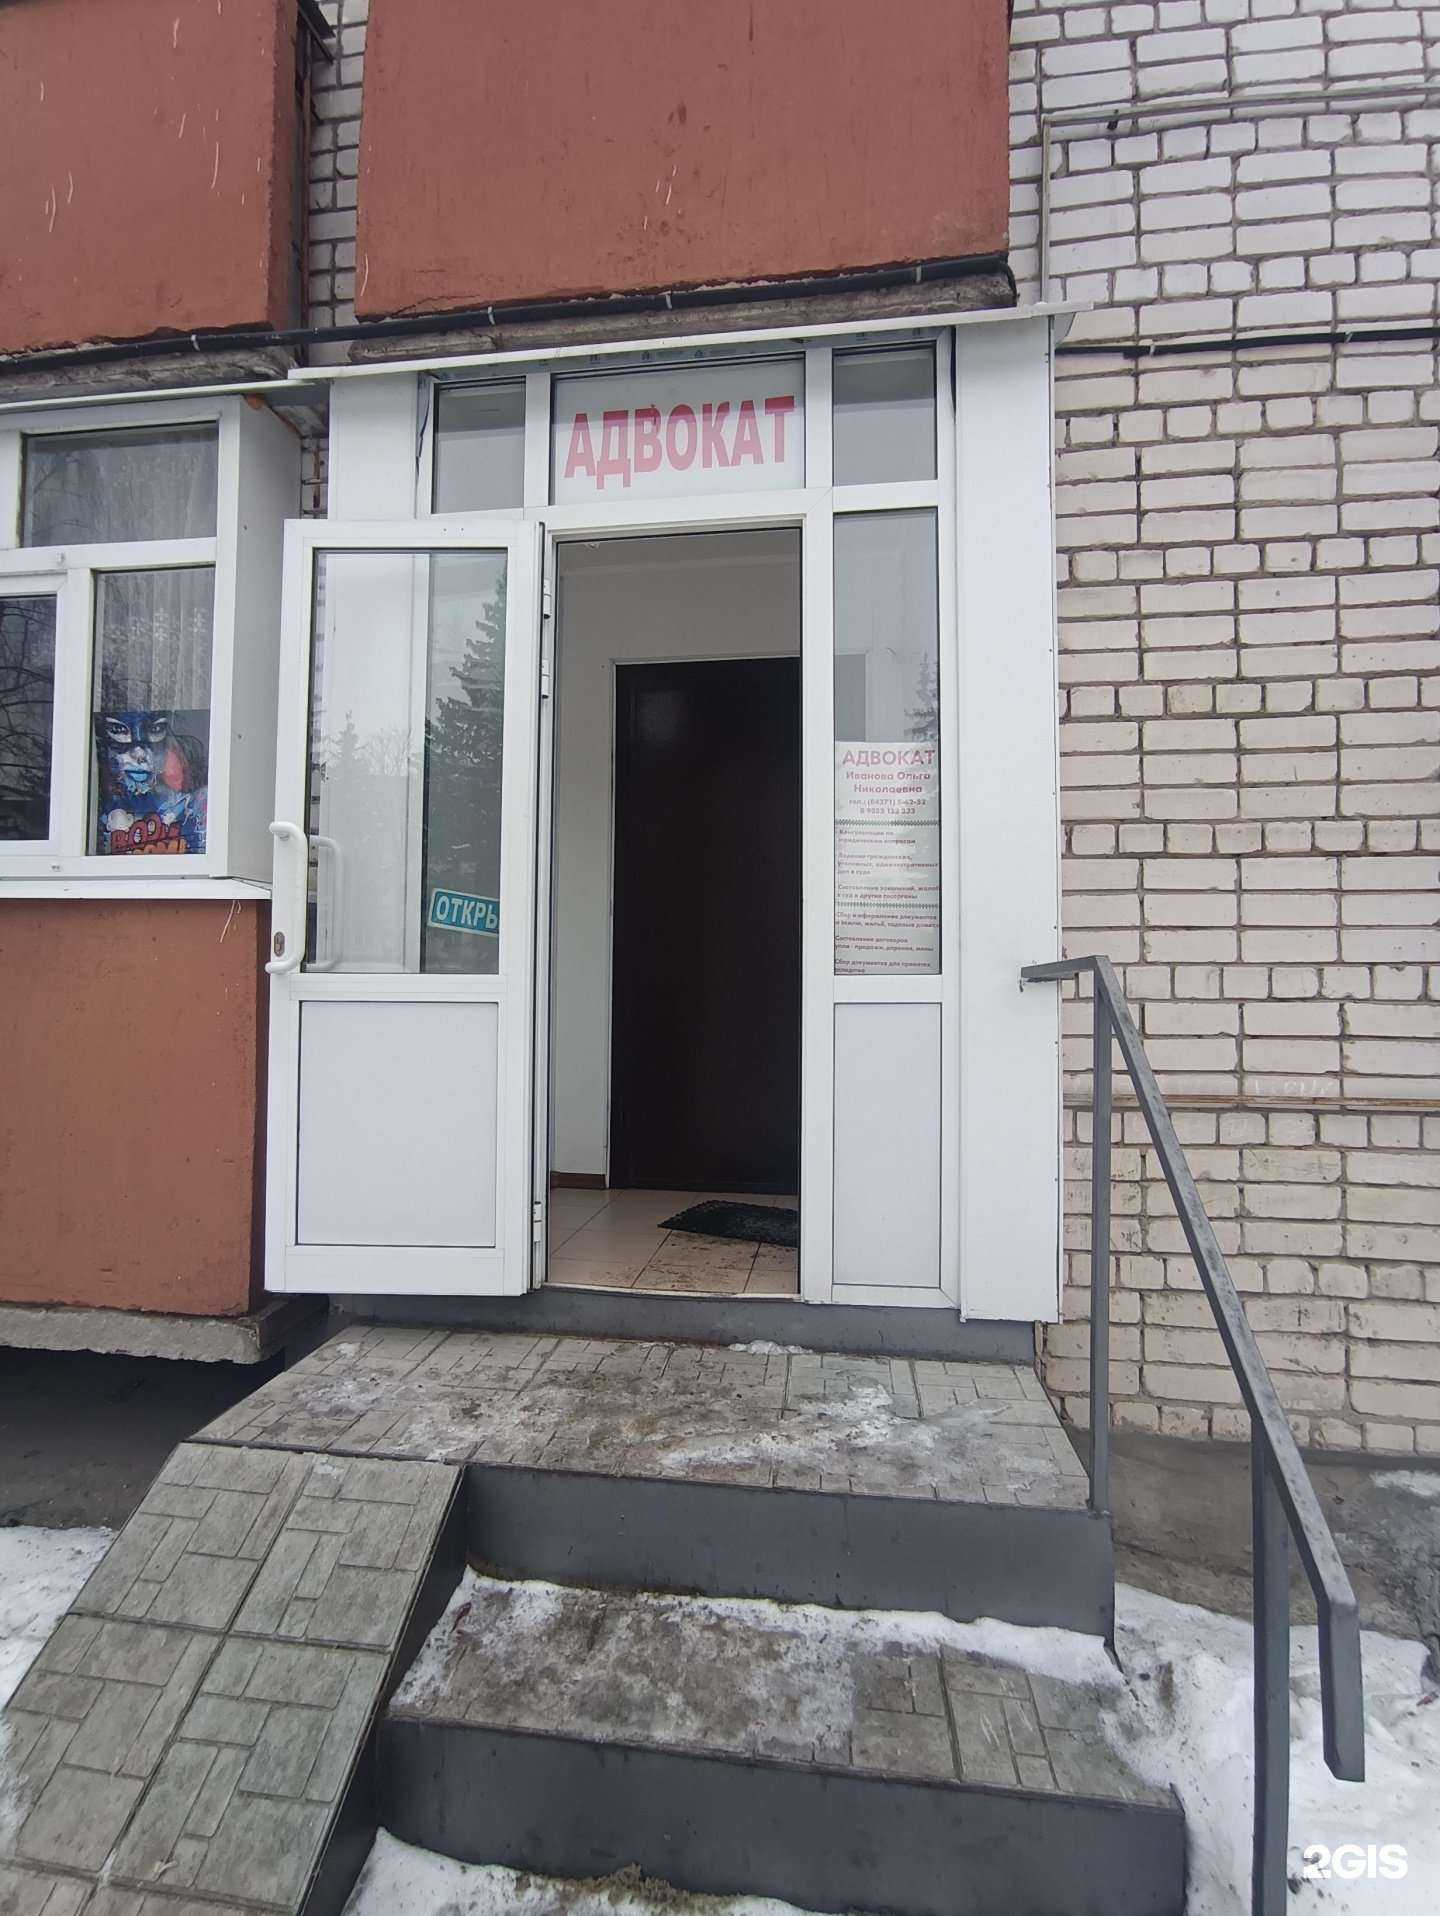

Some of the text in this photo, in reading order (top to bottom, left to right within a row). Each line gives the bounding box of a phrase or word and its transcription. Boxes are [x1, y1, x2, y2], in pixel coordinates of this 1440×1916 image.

[564, 396, 794, 489] АДВОКАТ
[842, 750, 936, 767] АДВОКАТ
[846, 770, 931, 780] Иванова Ольга
[854, 784, 922, 794] Николаевна
